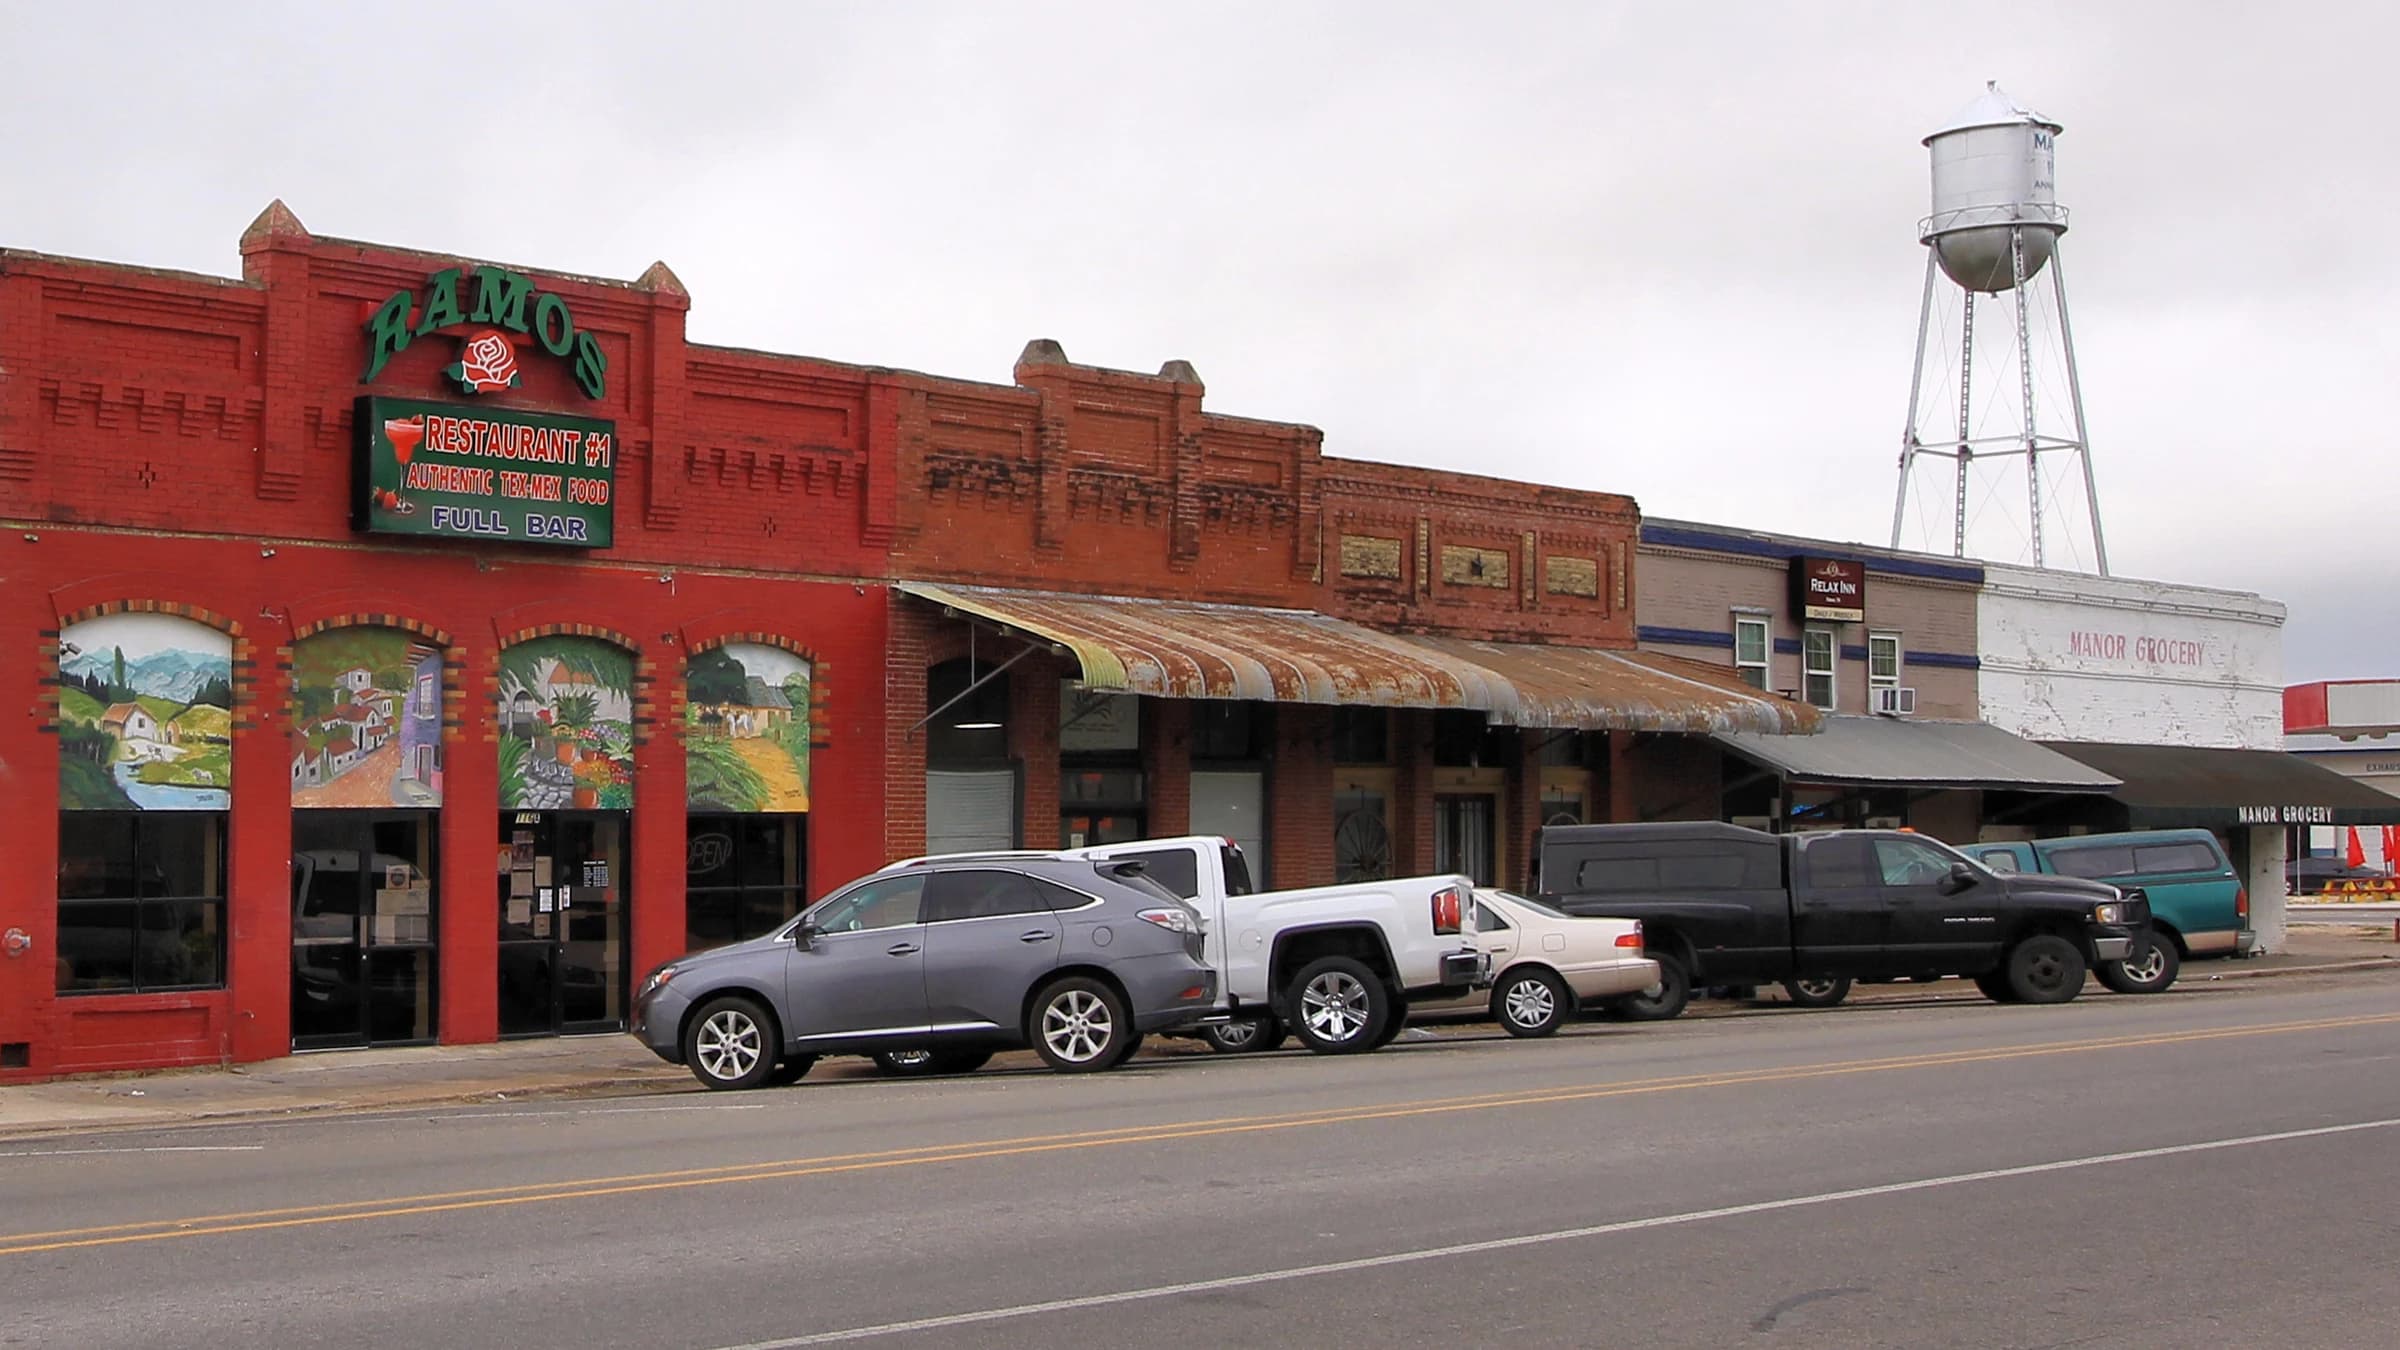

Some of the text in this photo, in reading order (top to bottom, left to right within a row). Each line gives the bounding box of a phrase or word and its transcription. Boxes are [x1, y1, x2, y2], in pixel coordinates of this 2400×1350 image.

[362, 266, 608, 399] RAMOS
[426, 416, 610, 466] RESTAURANT #1
[407, 464, 609, 505] AUTHENTIC TEX-MEX FOOD
[432, 506, 587, 540] FULL BAR
[1811, 578, 1856, 595] RELAX INN
[2070, 631, 2205, 666] MANOR GROCERY
[2238, 805, 2332, 823] MANOR GROCERY
[687, 840, 731, 865] PEN
